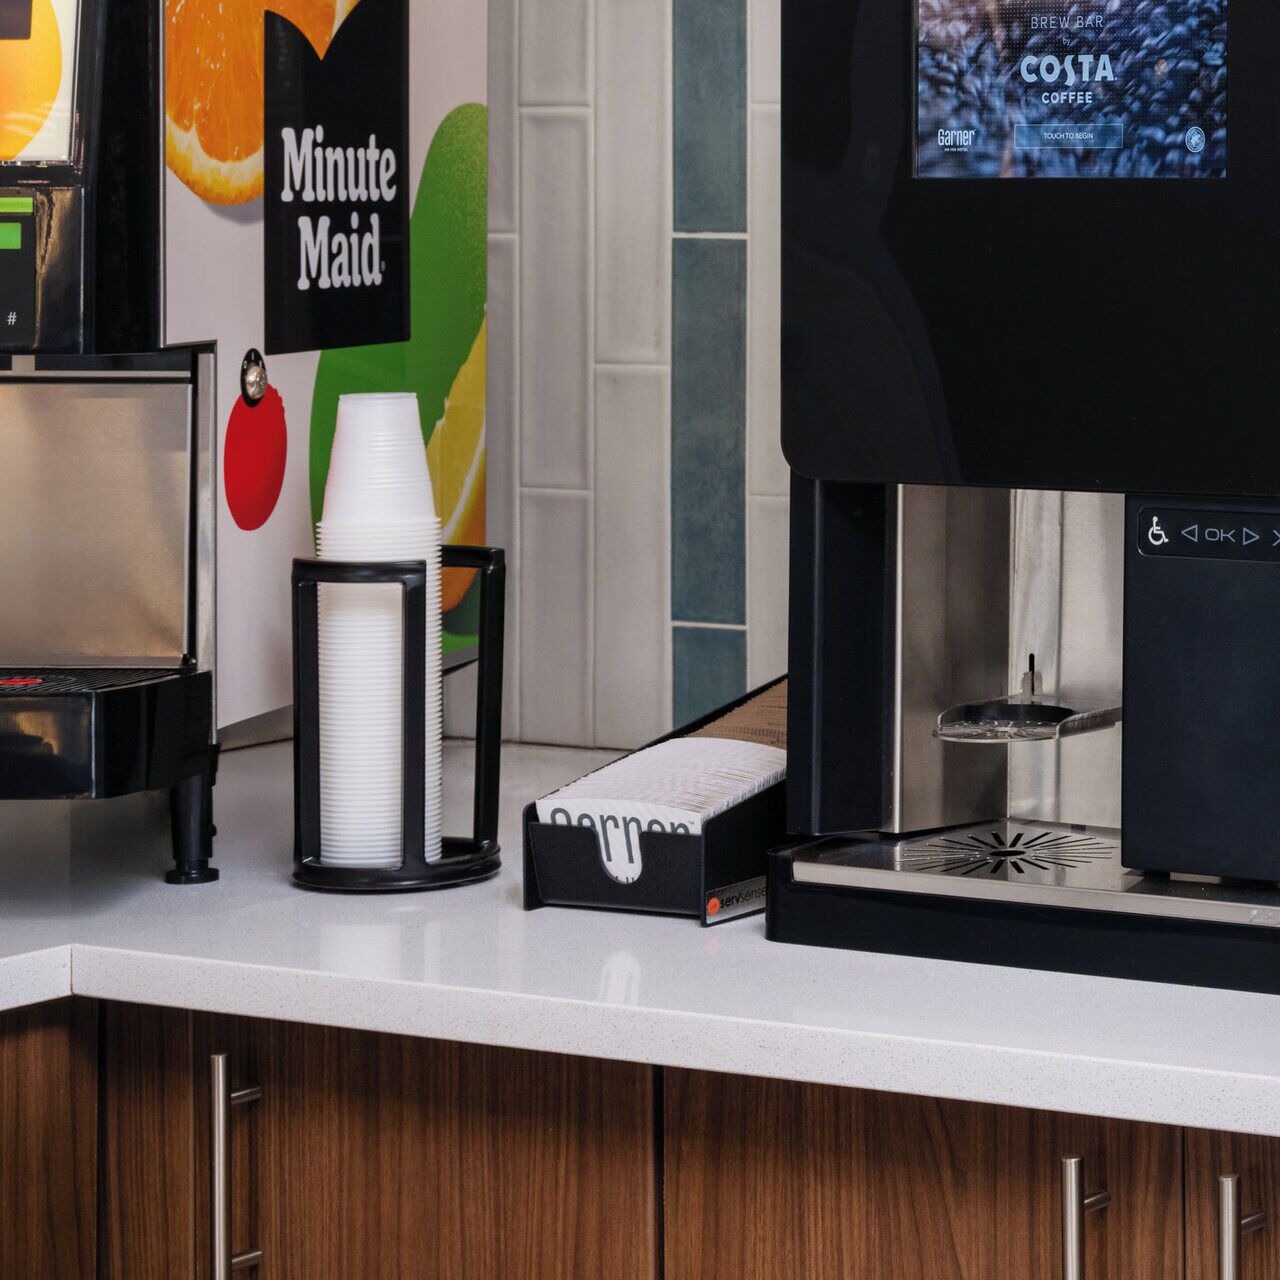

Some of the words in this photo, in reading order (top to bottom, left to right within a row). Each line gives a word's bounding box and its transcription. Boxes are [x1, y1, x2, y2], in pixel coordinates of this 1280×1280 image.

[1030, 16, 1071, 29] BREW
[1076, 15, 1104, 28] BAR
[1062, 37, 1071, 46] by
[1020, 54, 1115, 87] COSTA
[1041, 91, 1093, 104] COFFEE
[938, 128, 975, 146] Garner
[1075, 132, 1093, 140] BEGIN
[281, 124, 397, 202] Minute
[297, 211, 383, 290] Maid
[1204, 528, 1236, 543] OK
